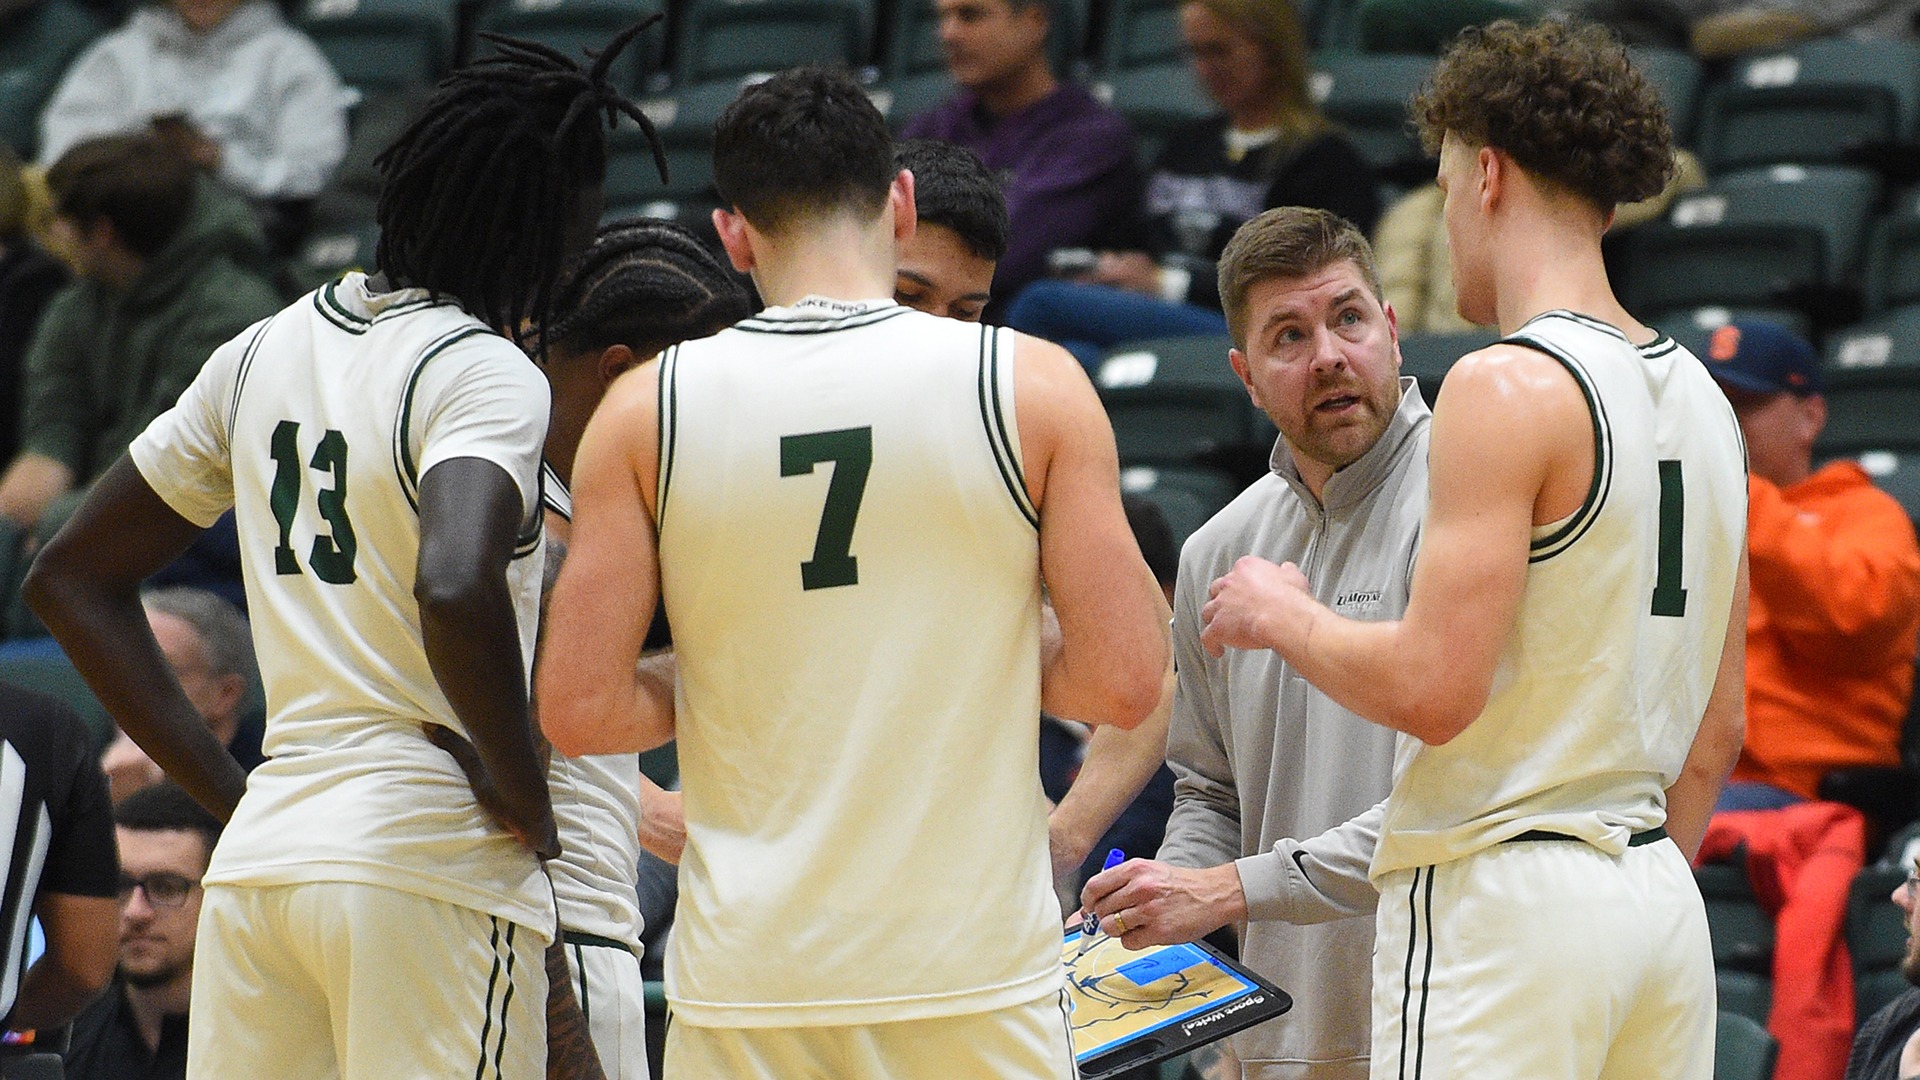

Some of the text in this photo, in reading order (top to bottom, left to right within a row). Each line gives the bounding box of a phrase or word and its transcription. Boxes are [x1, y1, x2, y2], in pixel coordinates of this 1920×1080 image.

[797, 299, 868, 315] IKE PRO
[270, 420, 358, 584] 13
[780, 425, 873, 591] 7
[1651, 460, 1688, 617] 1
[1225, 994, 1265, 1015] Sport
